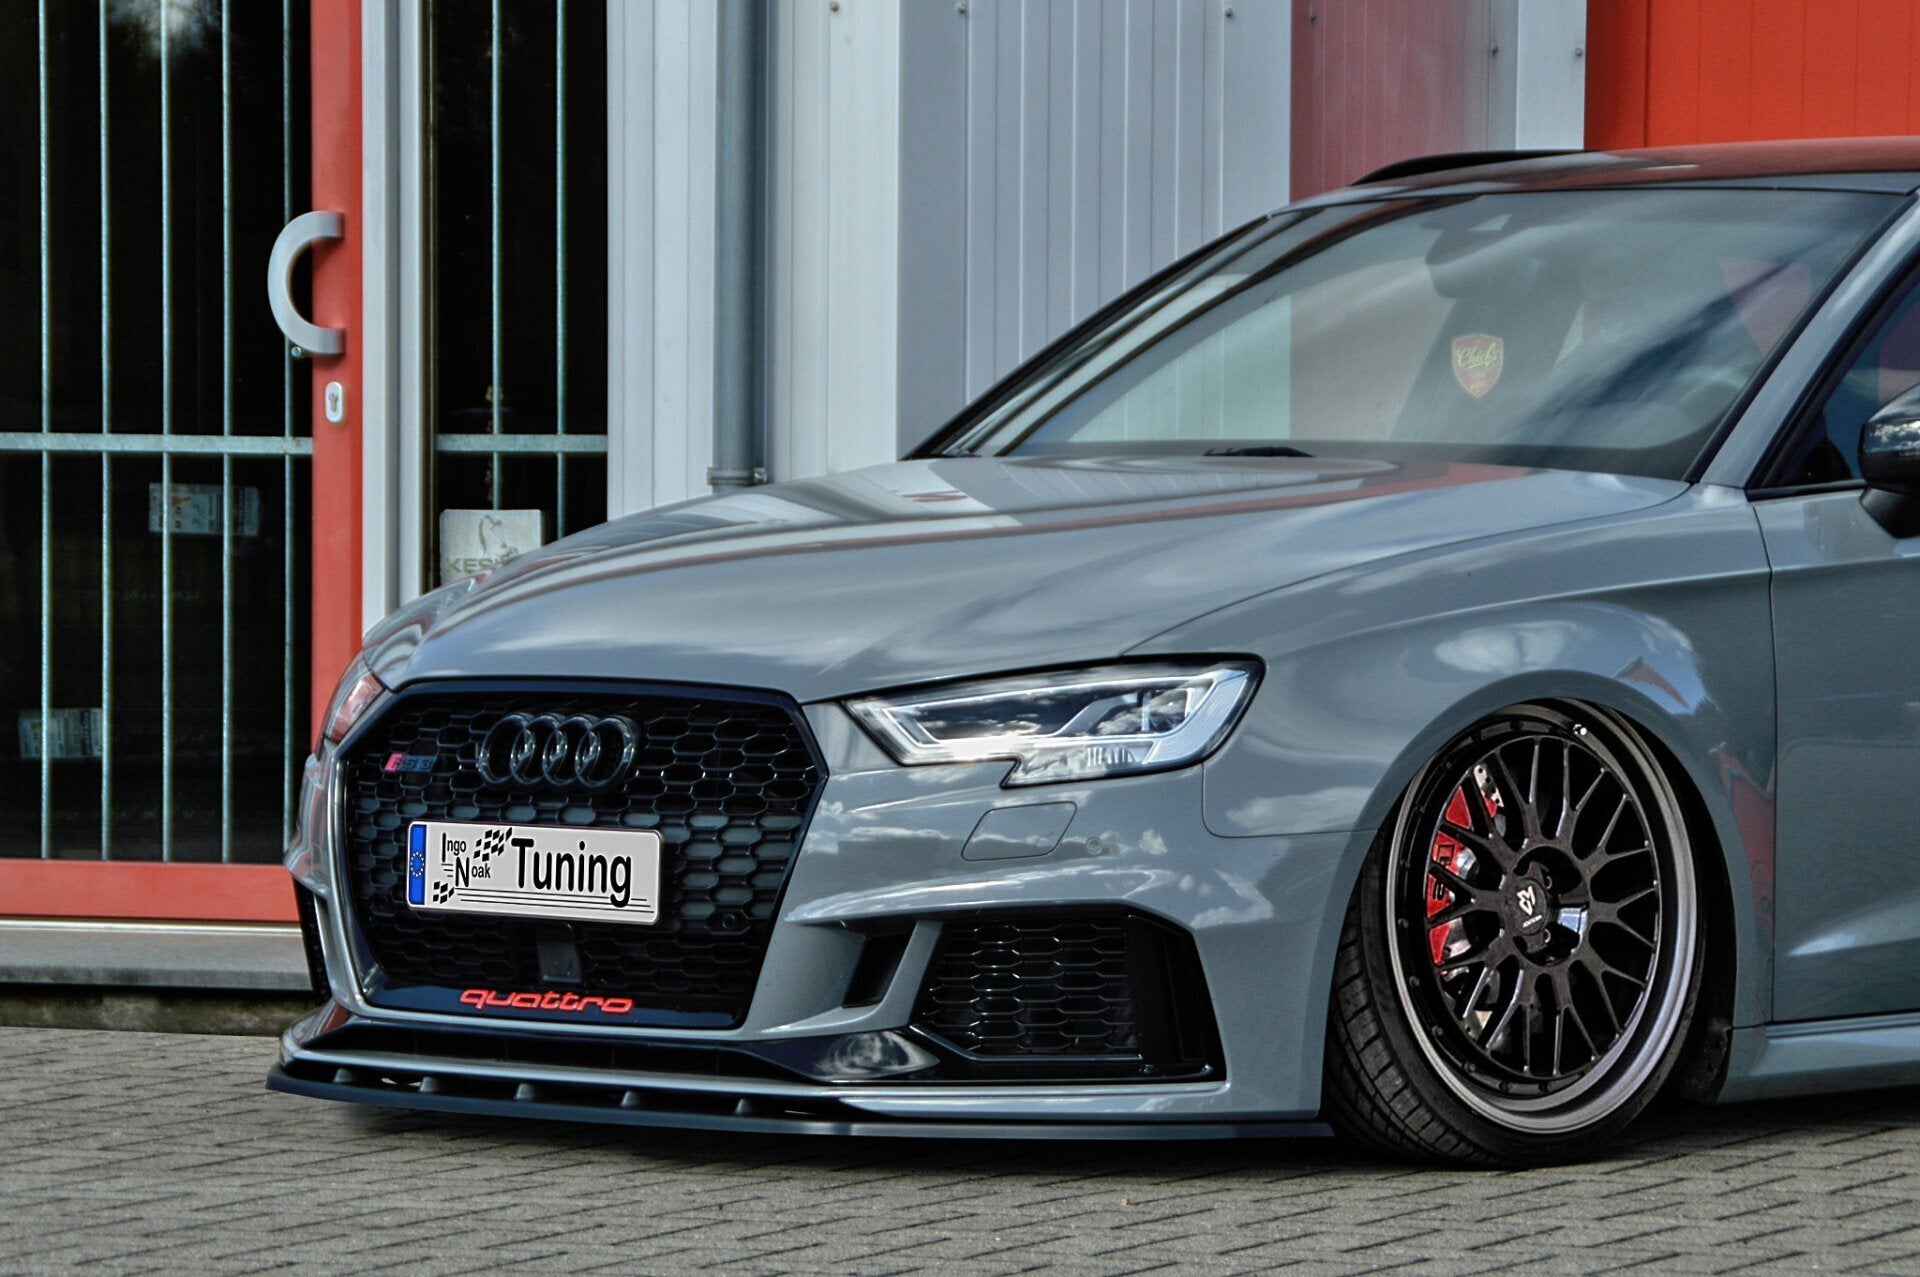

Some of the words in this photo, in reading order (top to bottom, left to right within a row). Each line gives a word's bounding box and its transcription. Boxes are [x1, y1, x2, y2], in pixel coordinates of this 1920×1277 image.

[442, 832, 467, 862] Ingo
[454, 856, 491, 887] Noak
[511, 838, 632, 907] Tuning
[460, 989, 633, 1013] quattro
